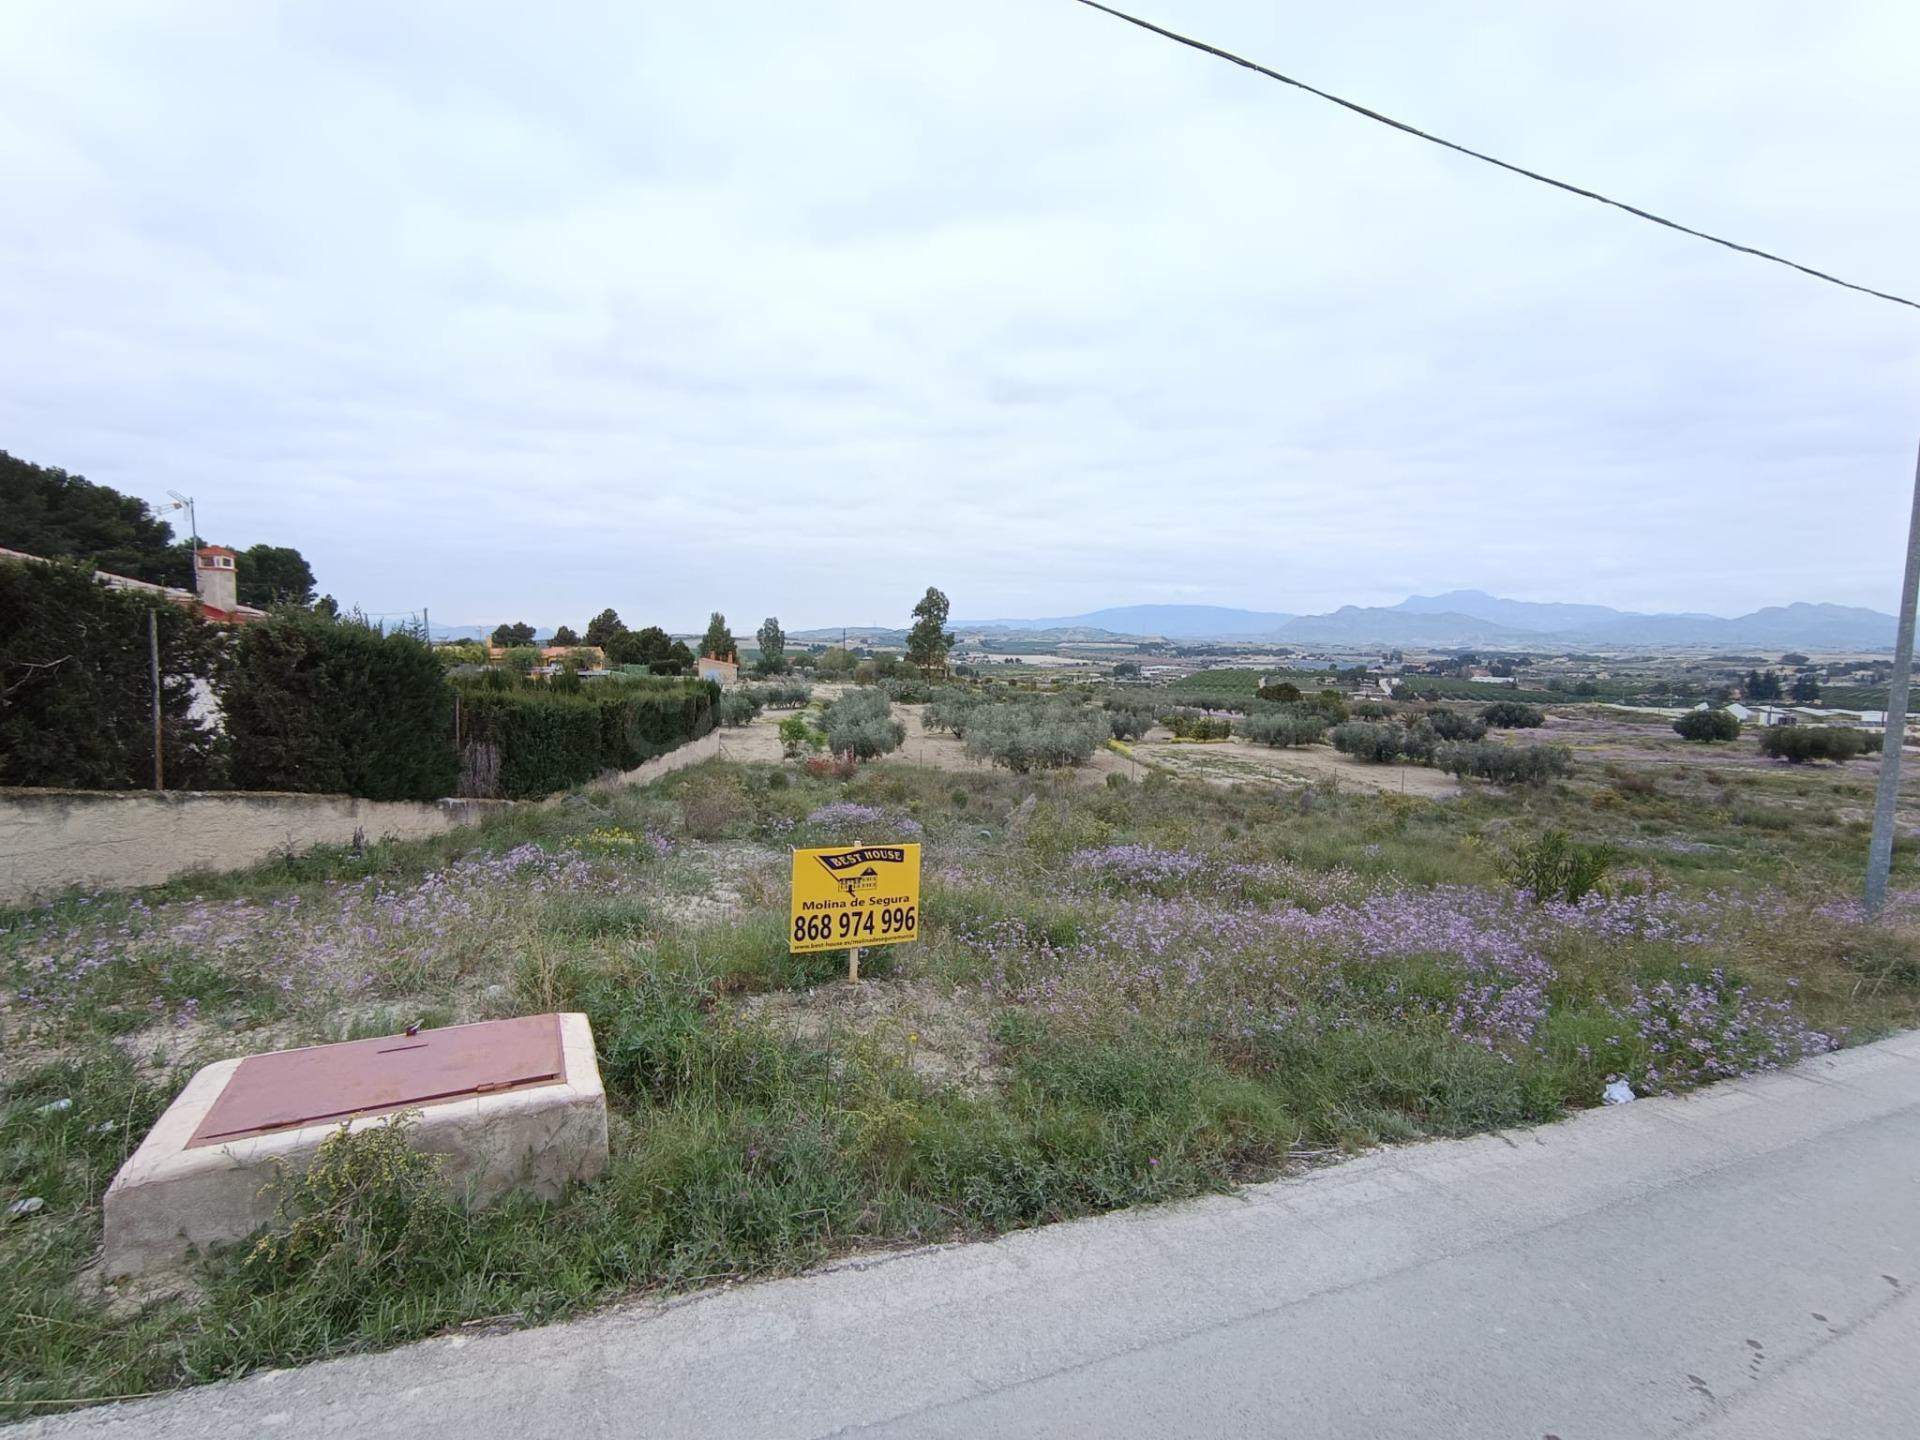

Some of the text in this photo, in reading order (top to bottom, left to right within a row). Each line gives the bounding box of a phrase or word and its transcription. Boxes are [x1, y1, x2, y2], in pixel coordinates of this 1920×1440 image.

[829, 849, 902, 867] BEST HOUSE
[802, 895, 910, 911] Molina de Segura
[794, 906, 916, 942] 868 974 996
